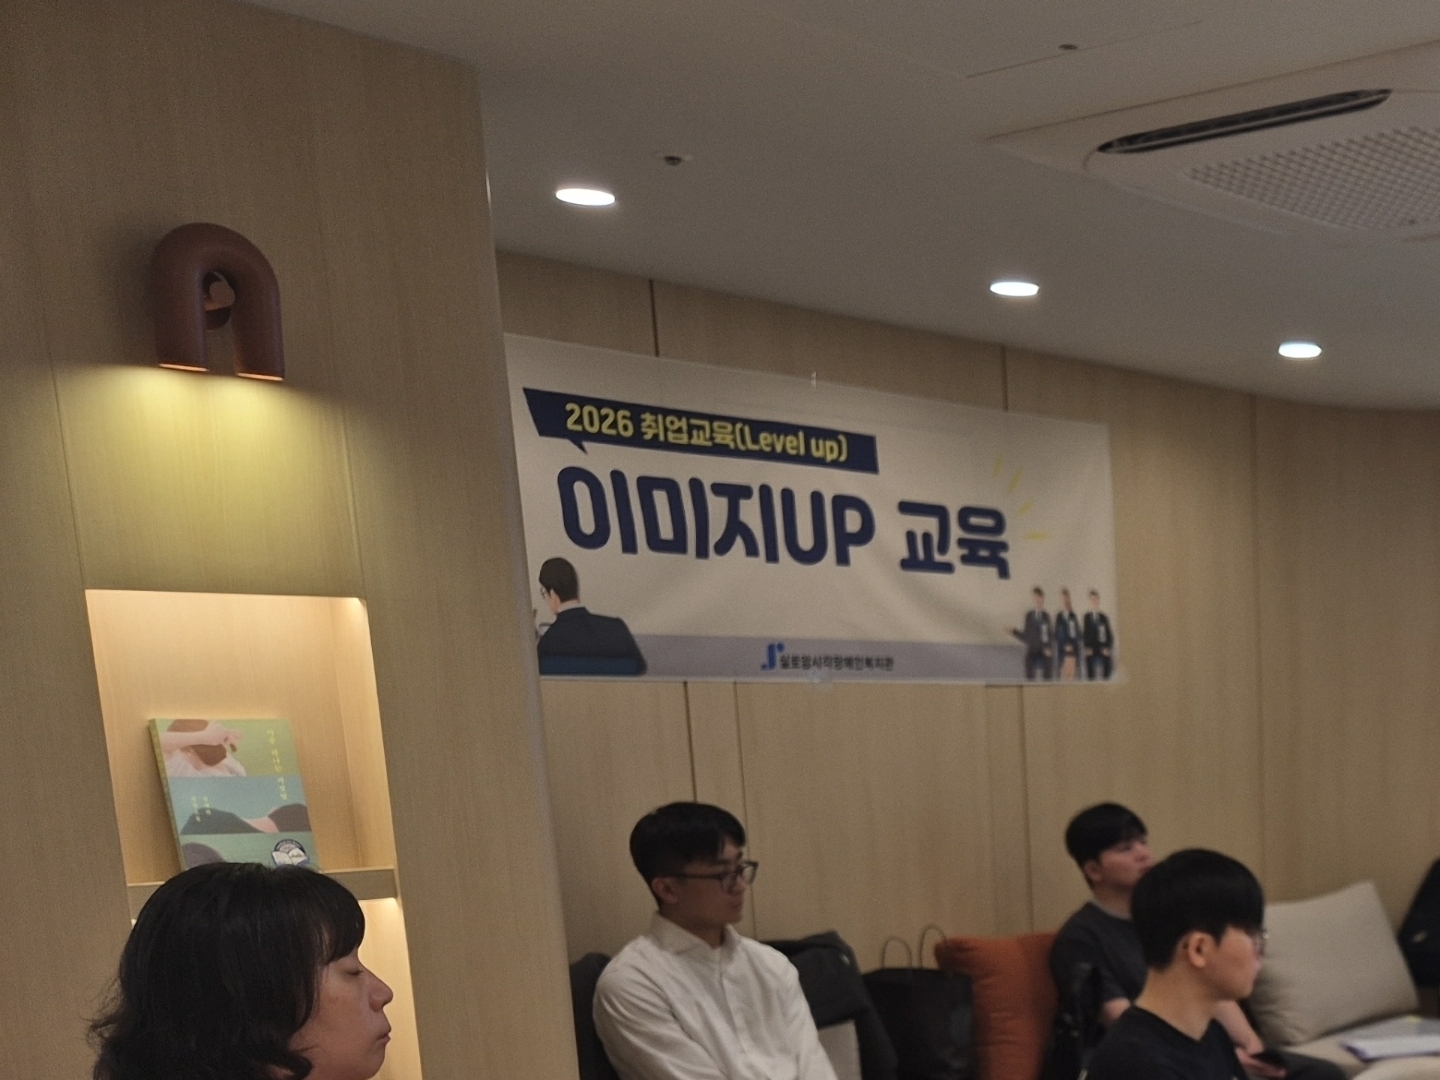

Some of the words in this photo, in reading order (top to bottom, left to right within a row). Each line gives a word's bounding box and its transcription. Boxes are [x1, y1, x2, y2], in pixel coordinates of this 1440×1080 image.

[565, 402, 635, 438] 2026
[640, 411, 806, 456] 취업교육(Level
[810, 434, 849, 463] up)
[557, 466, 876, 567] 이미지UP
[897, 500, 1011, 580] 교육
